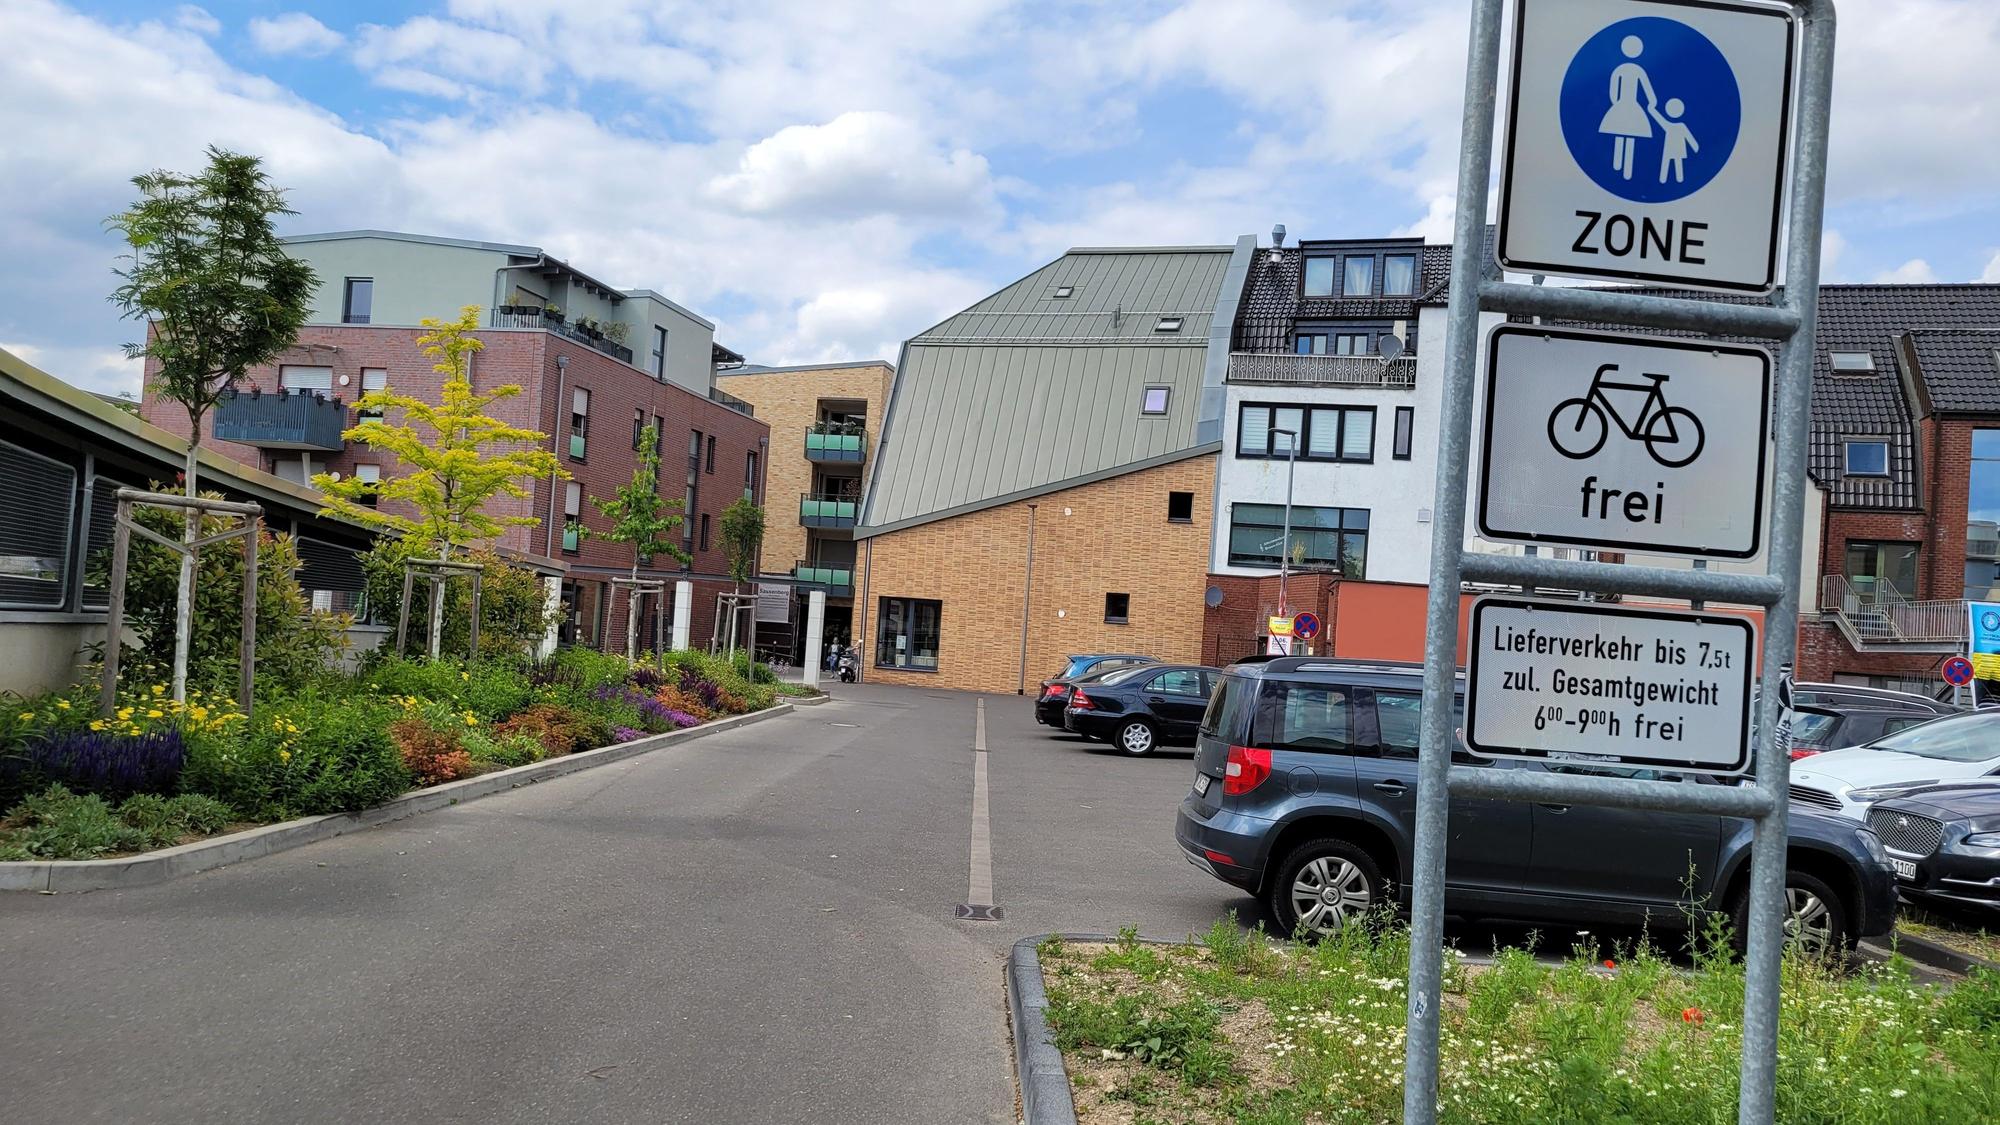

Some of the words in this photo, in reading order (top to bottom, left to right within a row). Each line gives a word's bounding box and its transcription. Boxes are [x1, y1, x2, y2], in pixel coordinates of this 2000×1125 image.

[1571, 210, 1708, 265] ZONE
[1581, 476, 1664, 524] frei
[1494, 626, 1643, 661] Lieferverkehr
[1655, 638, 1686, 665] bis
[1502, 667, 1540, 692] zul.
[1552, 668, 1719, 706] Gesamtgewicht
[1634, 713, 1684, 742] frei
